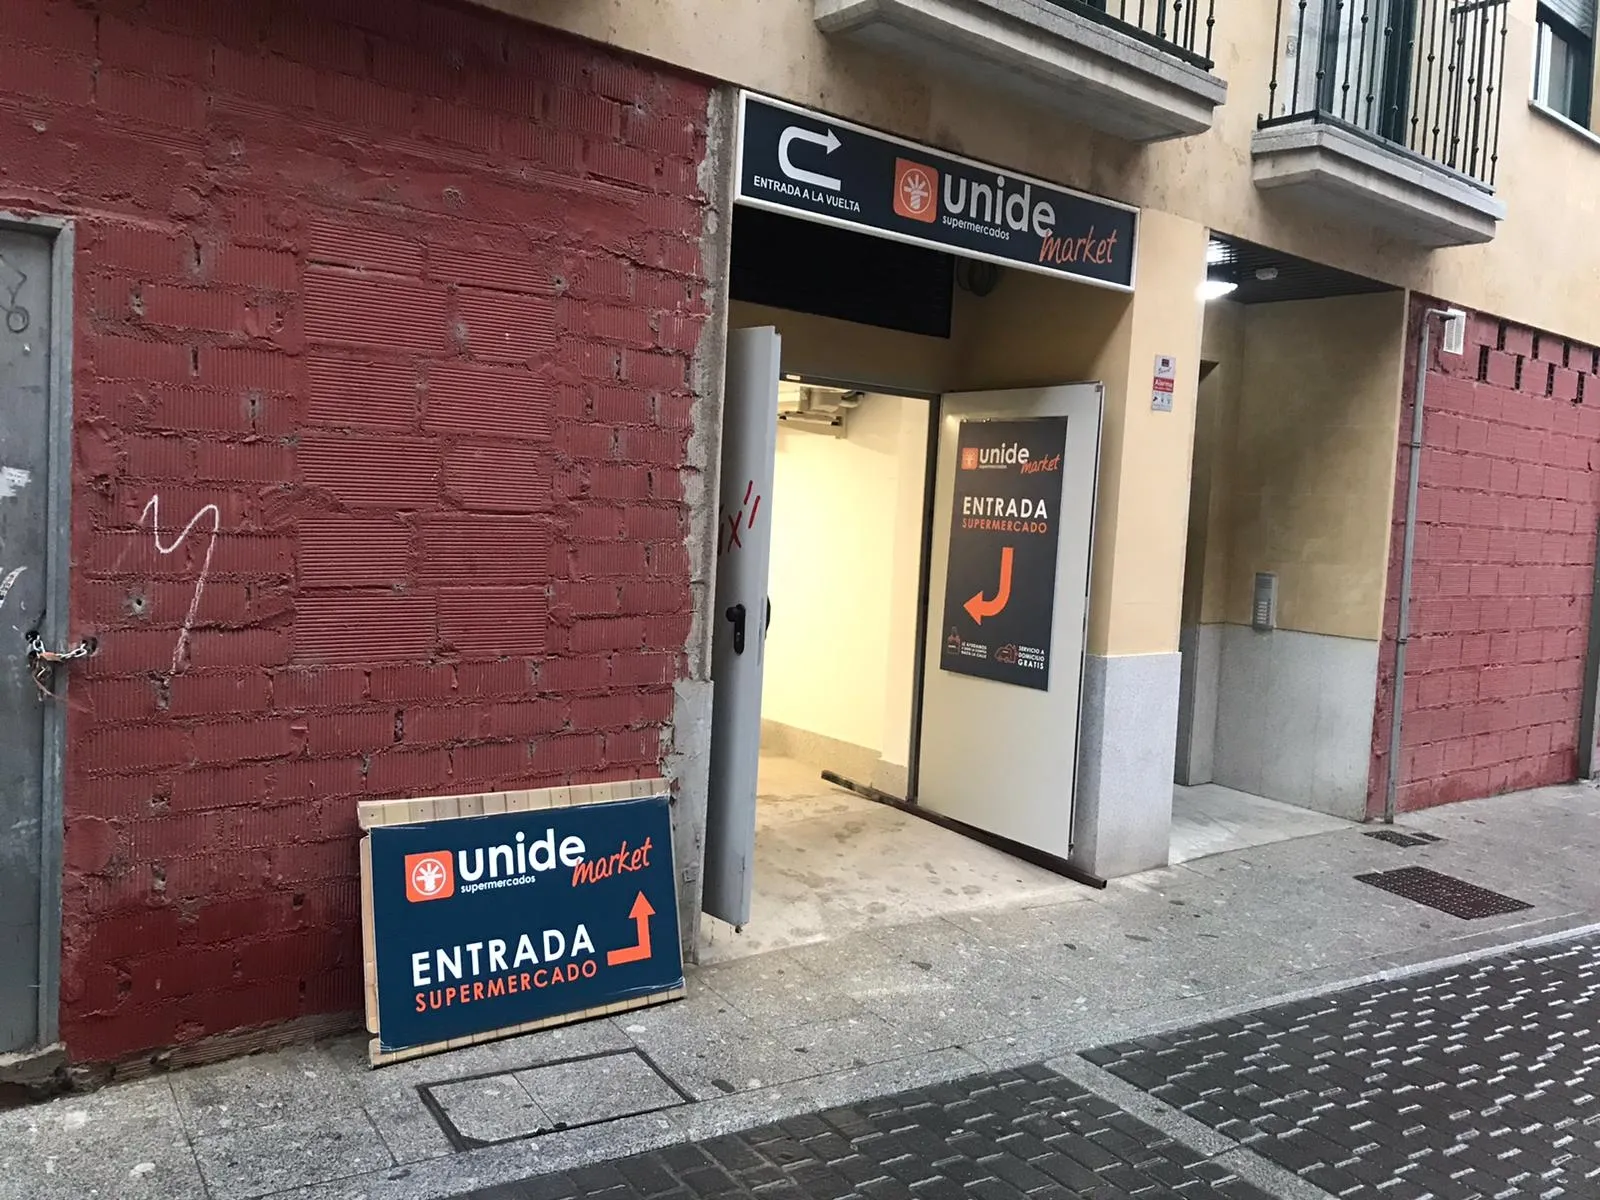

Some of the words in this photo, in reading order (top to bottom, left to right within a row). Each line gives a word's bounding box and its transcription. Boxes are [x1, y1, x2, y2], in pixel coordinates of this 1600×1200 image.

[753, 175, 801, 198] ENTRADA
[802, 188, 810, 199] A
[811, 190, 824, 203] LA
[826, 194, 861, 213] VUELTA
[942, 214, 1011, 241] supermercados
[943, 173, 1056, 238] unide
[1038, 225, 1118, 265] market
[979, 442, 1030, 465] unide
[1020, 453, 1061, 475] market
[962, 496, 1048, 519] ENTRADA
[961, 517, 1048, 534] SUPERMERCADO
[1018, 645, 1040, 655] SERVICIO
[1018, 652, 1046, 662] DOMICILIO
[1018, 658, 1045, 670] GRATIS
[457, 828, 586, 882] unide
[571, 836, 653, 888] market
[460, 874, 536, 894] supermercados
[411, 923, 596, 987] ENTRADA
[415, 959, 598, 1013] SUPERMERCADO
